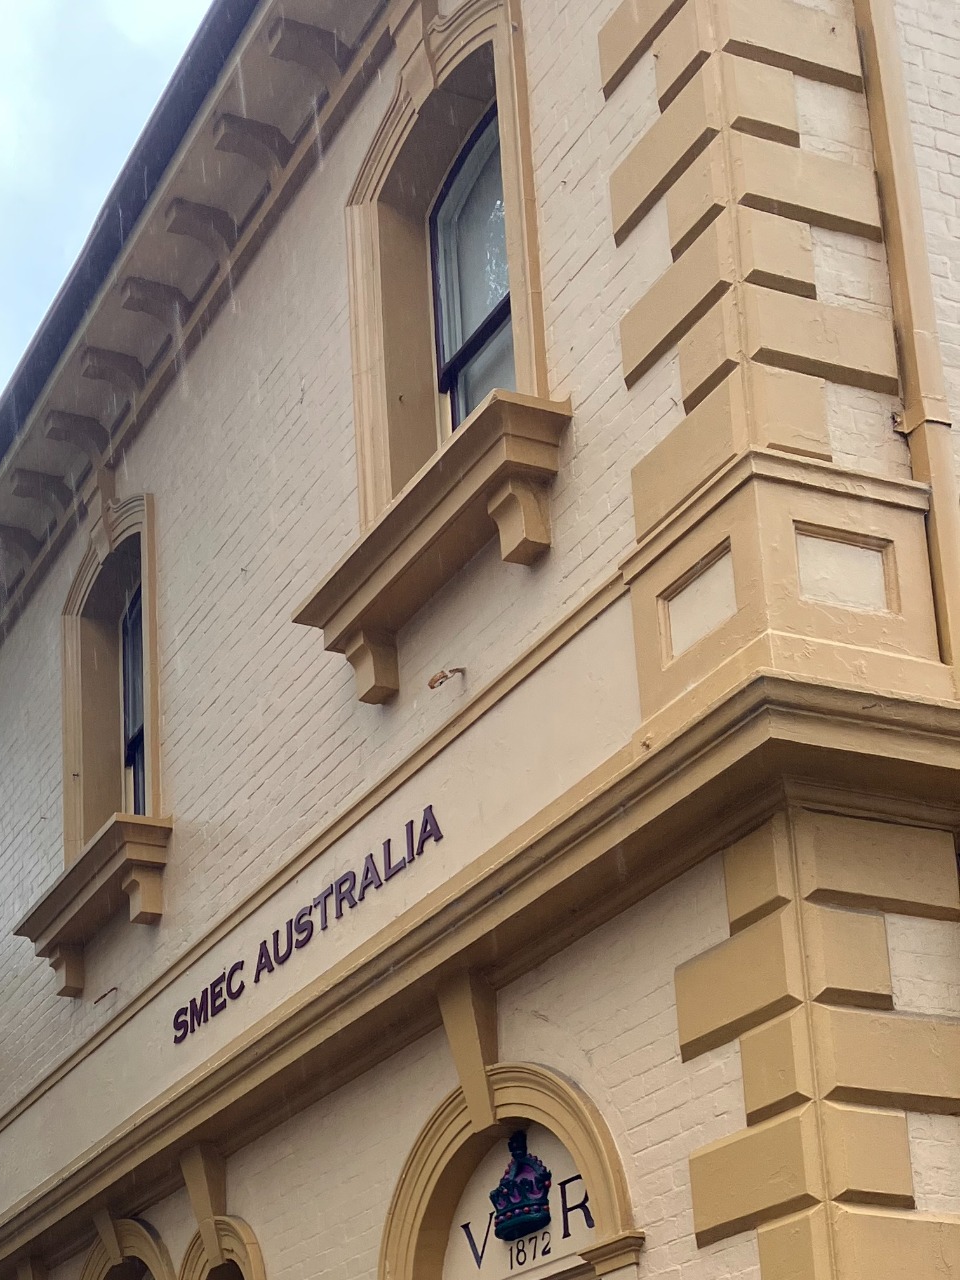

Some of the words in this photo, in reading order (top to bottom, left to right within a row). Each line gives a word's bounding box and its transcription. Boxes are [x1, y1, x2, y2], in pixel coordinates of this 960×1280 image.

[173, 960, 245, 1044] SMEC
[253, 804, 444, 983] AUSTRALIA
[460, 1211, 494, 1270] V
[557, 1173, 595, 1240] R
[508, 1231, 552, 1270] 1872
